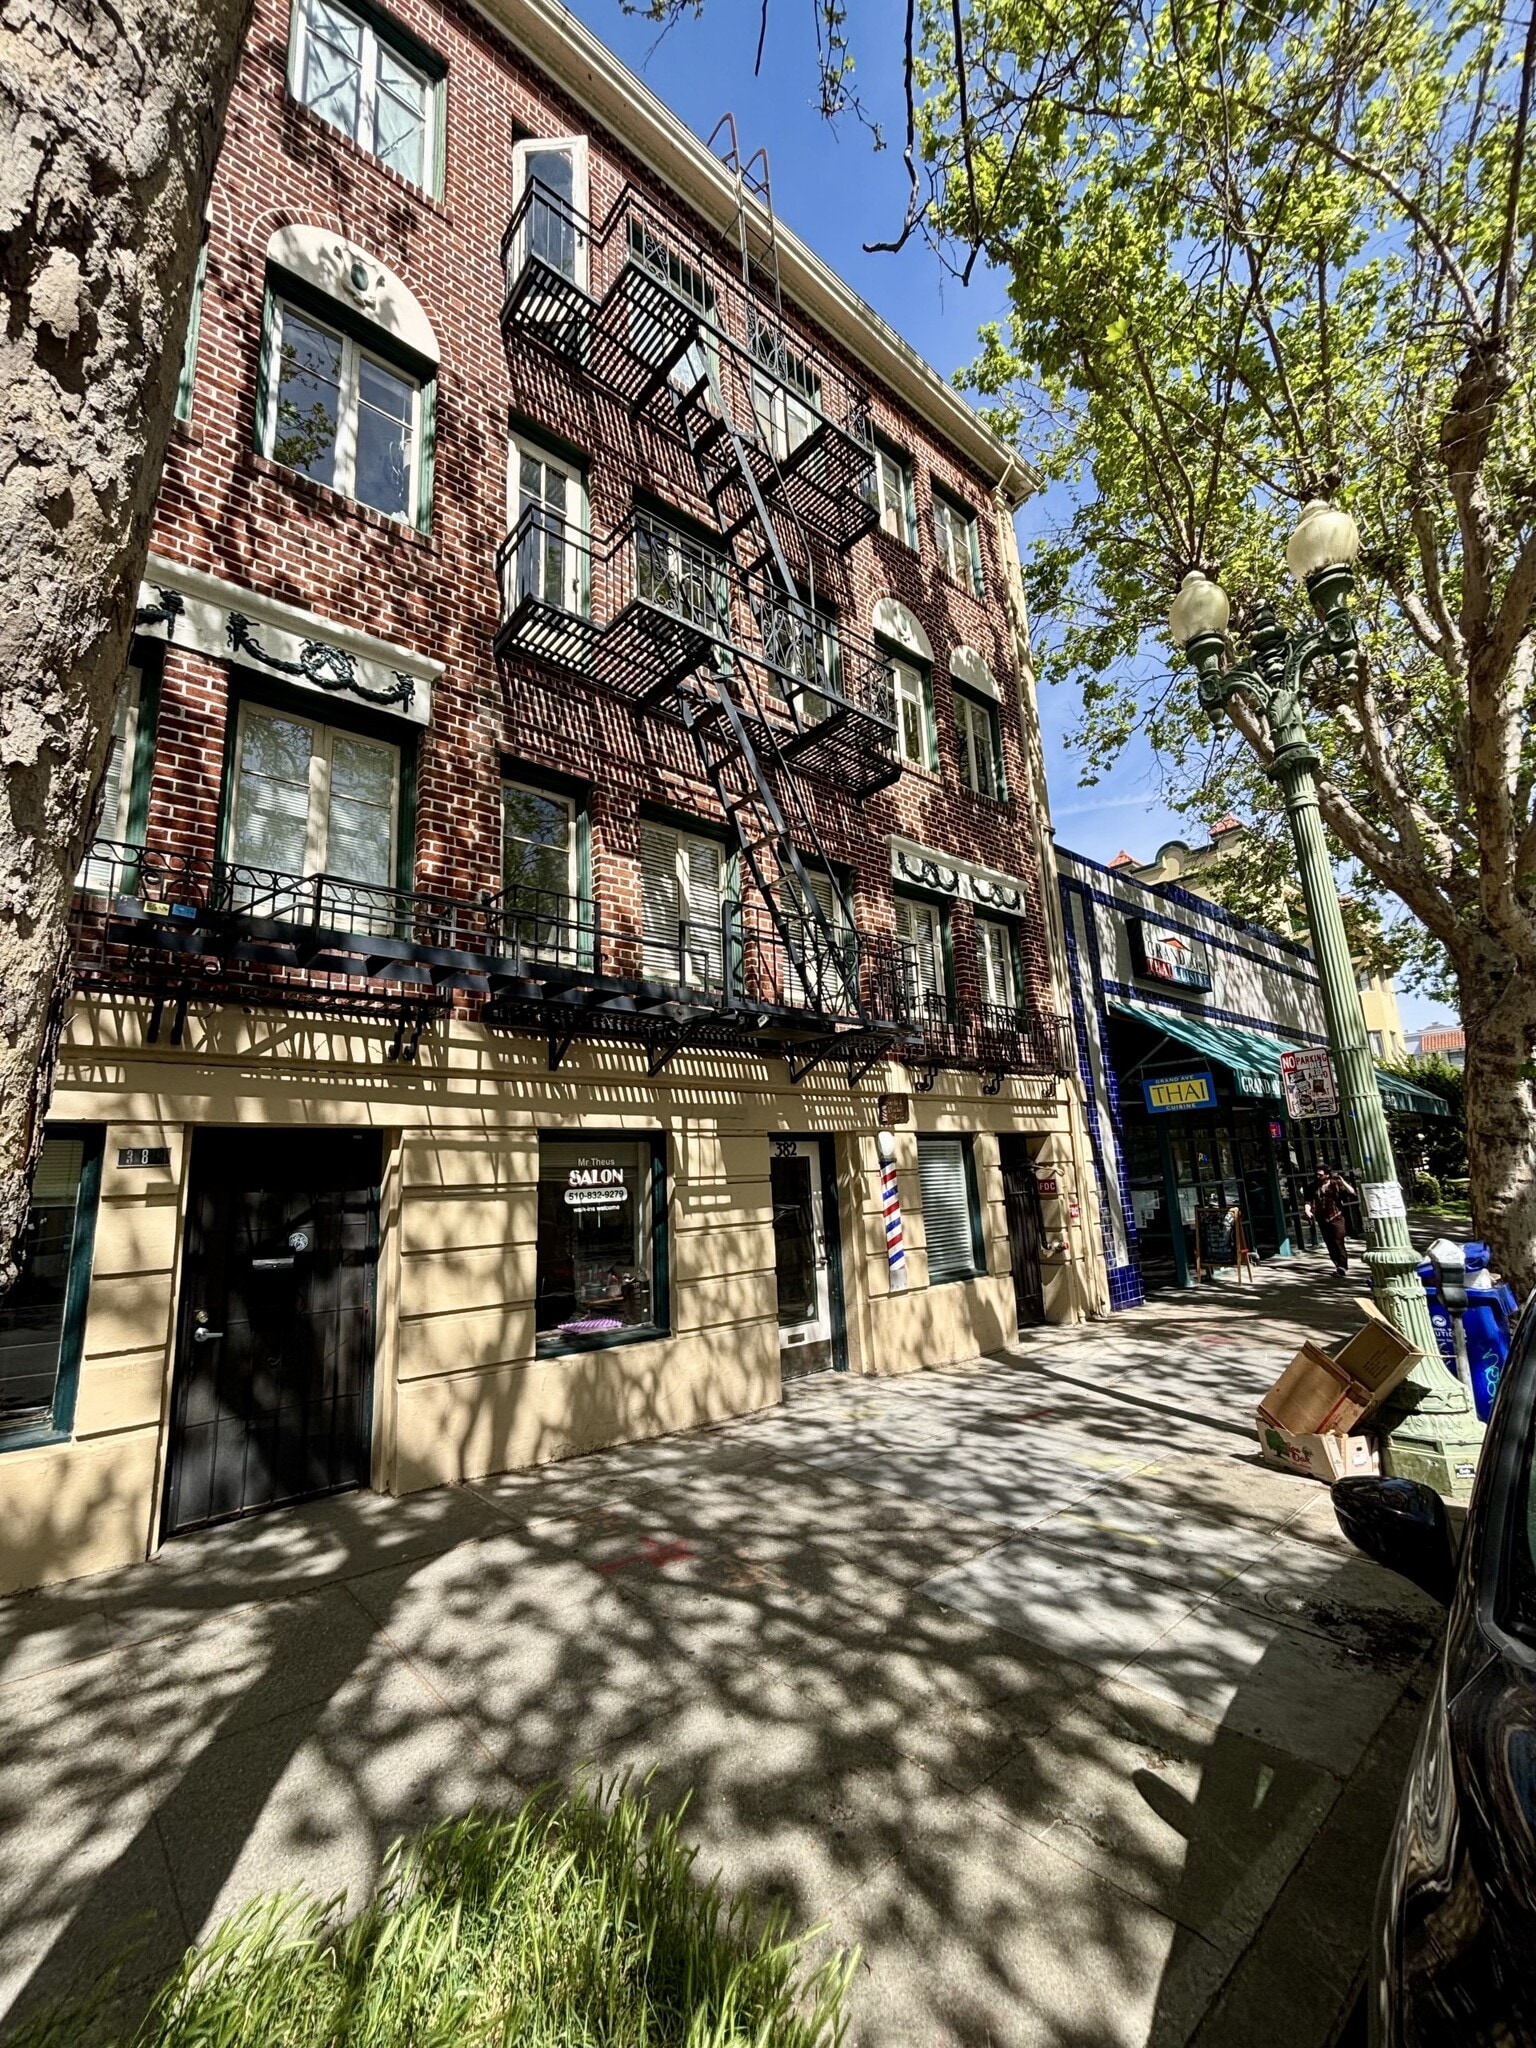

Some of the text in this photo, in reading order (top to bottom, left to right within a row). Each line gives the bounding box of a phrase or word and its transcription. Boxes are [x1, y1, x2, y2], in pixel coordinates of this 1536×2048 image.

[1147, 957, 1210, 988] THAI CUISINE
[1282, 1053, 1328, 1070] NO PARKING
[1155, 1077, 1179, 1085] GRAND
[1241, 1076, 1271, 1094] GRAND
[1152, 1081, 1206, 1104] THAI
[1165, 1103, 1196, 1111] CUISINE
[774, 1141, 798, 1158] 382
[590, 1157, 615, 1167] Theus
[568, 1168, 624, 1187] SALON
[1039, 1182, 1056, 1191] FDC
[568, 1190, 624, 1201] 510-832-9279
